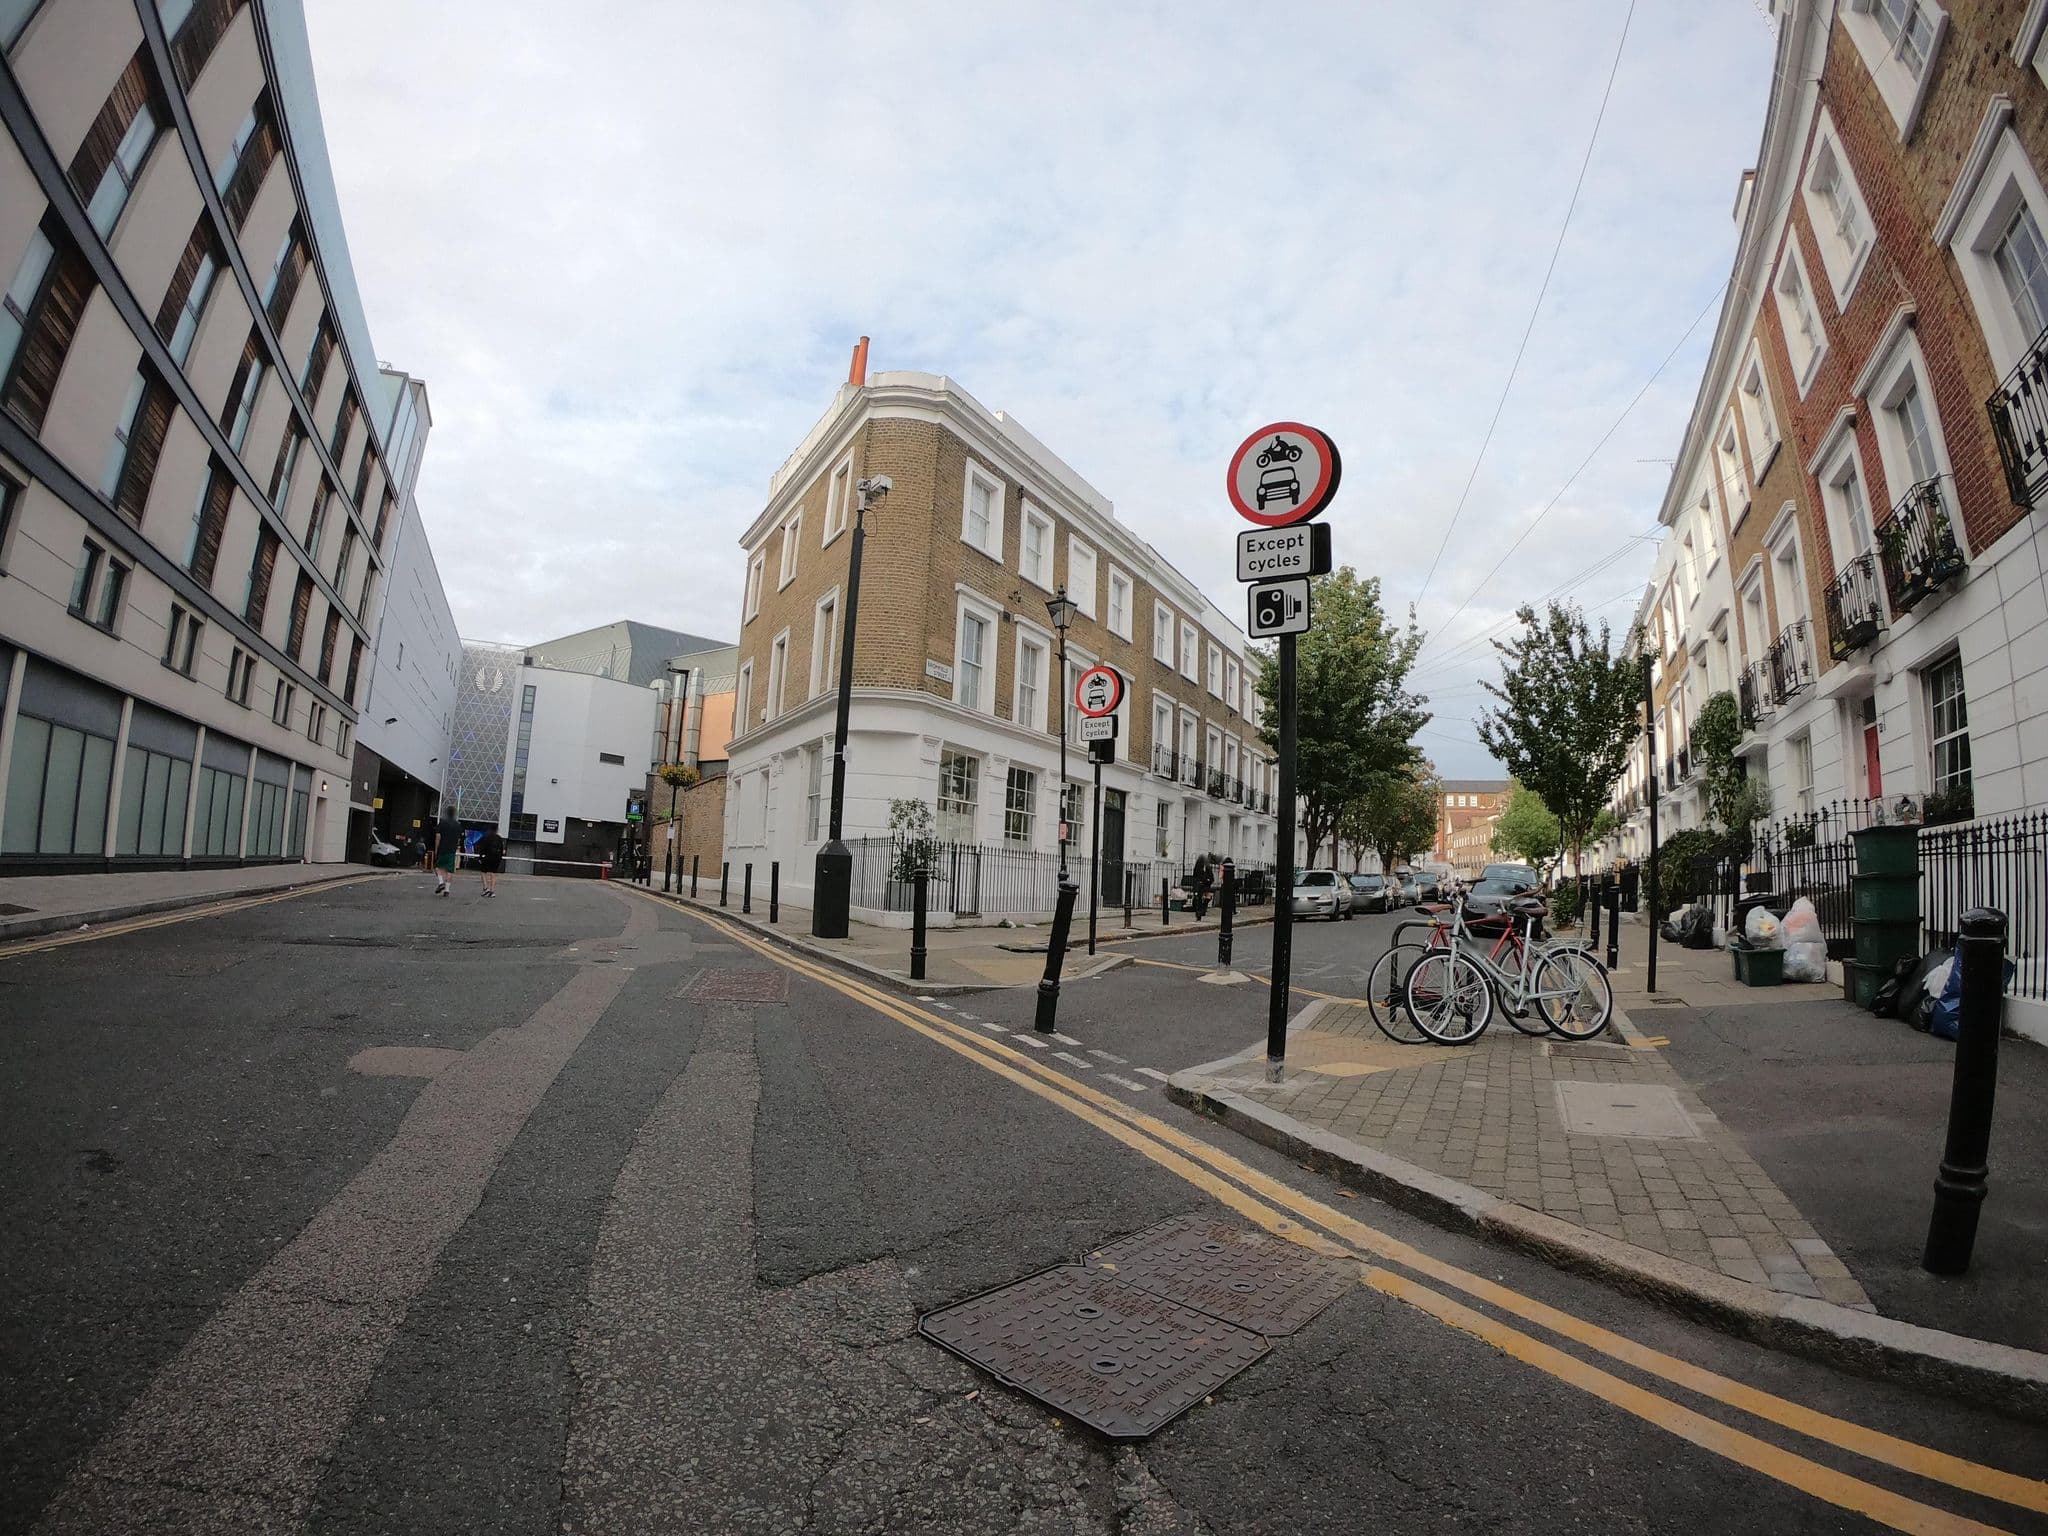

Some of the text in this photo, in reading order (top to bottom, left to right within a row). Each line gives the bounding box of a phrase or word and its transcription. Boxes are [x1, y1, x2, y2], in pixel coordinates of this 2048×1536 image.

[1247, 533, 1304, 552] Except
[1248, 554, 1301, 572] cycles
[1085, 720, 1110, 729] Except
[1085, 729, 1108, 737] cycles
